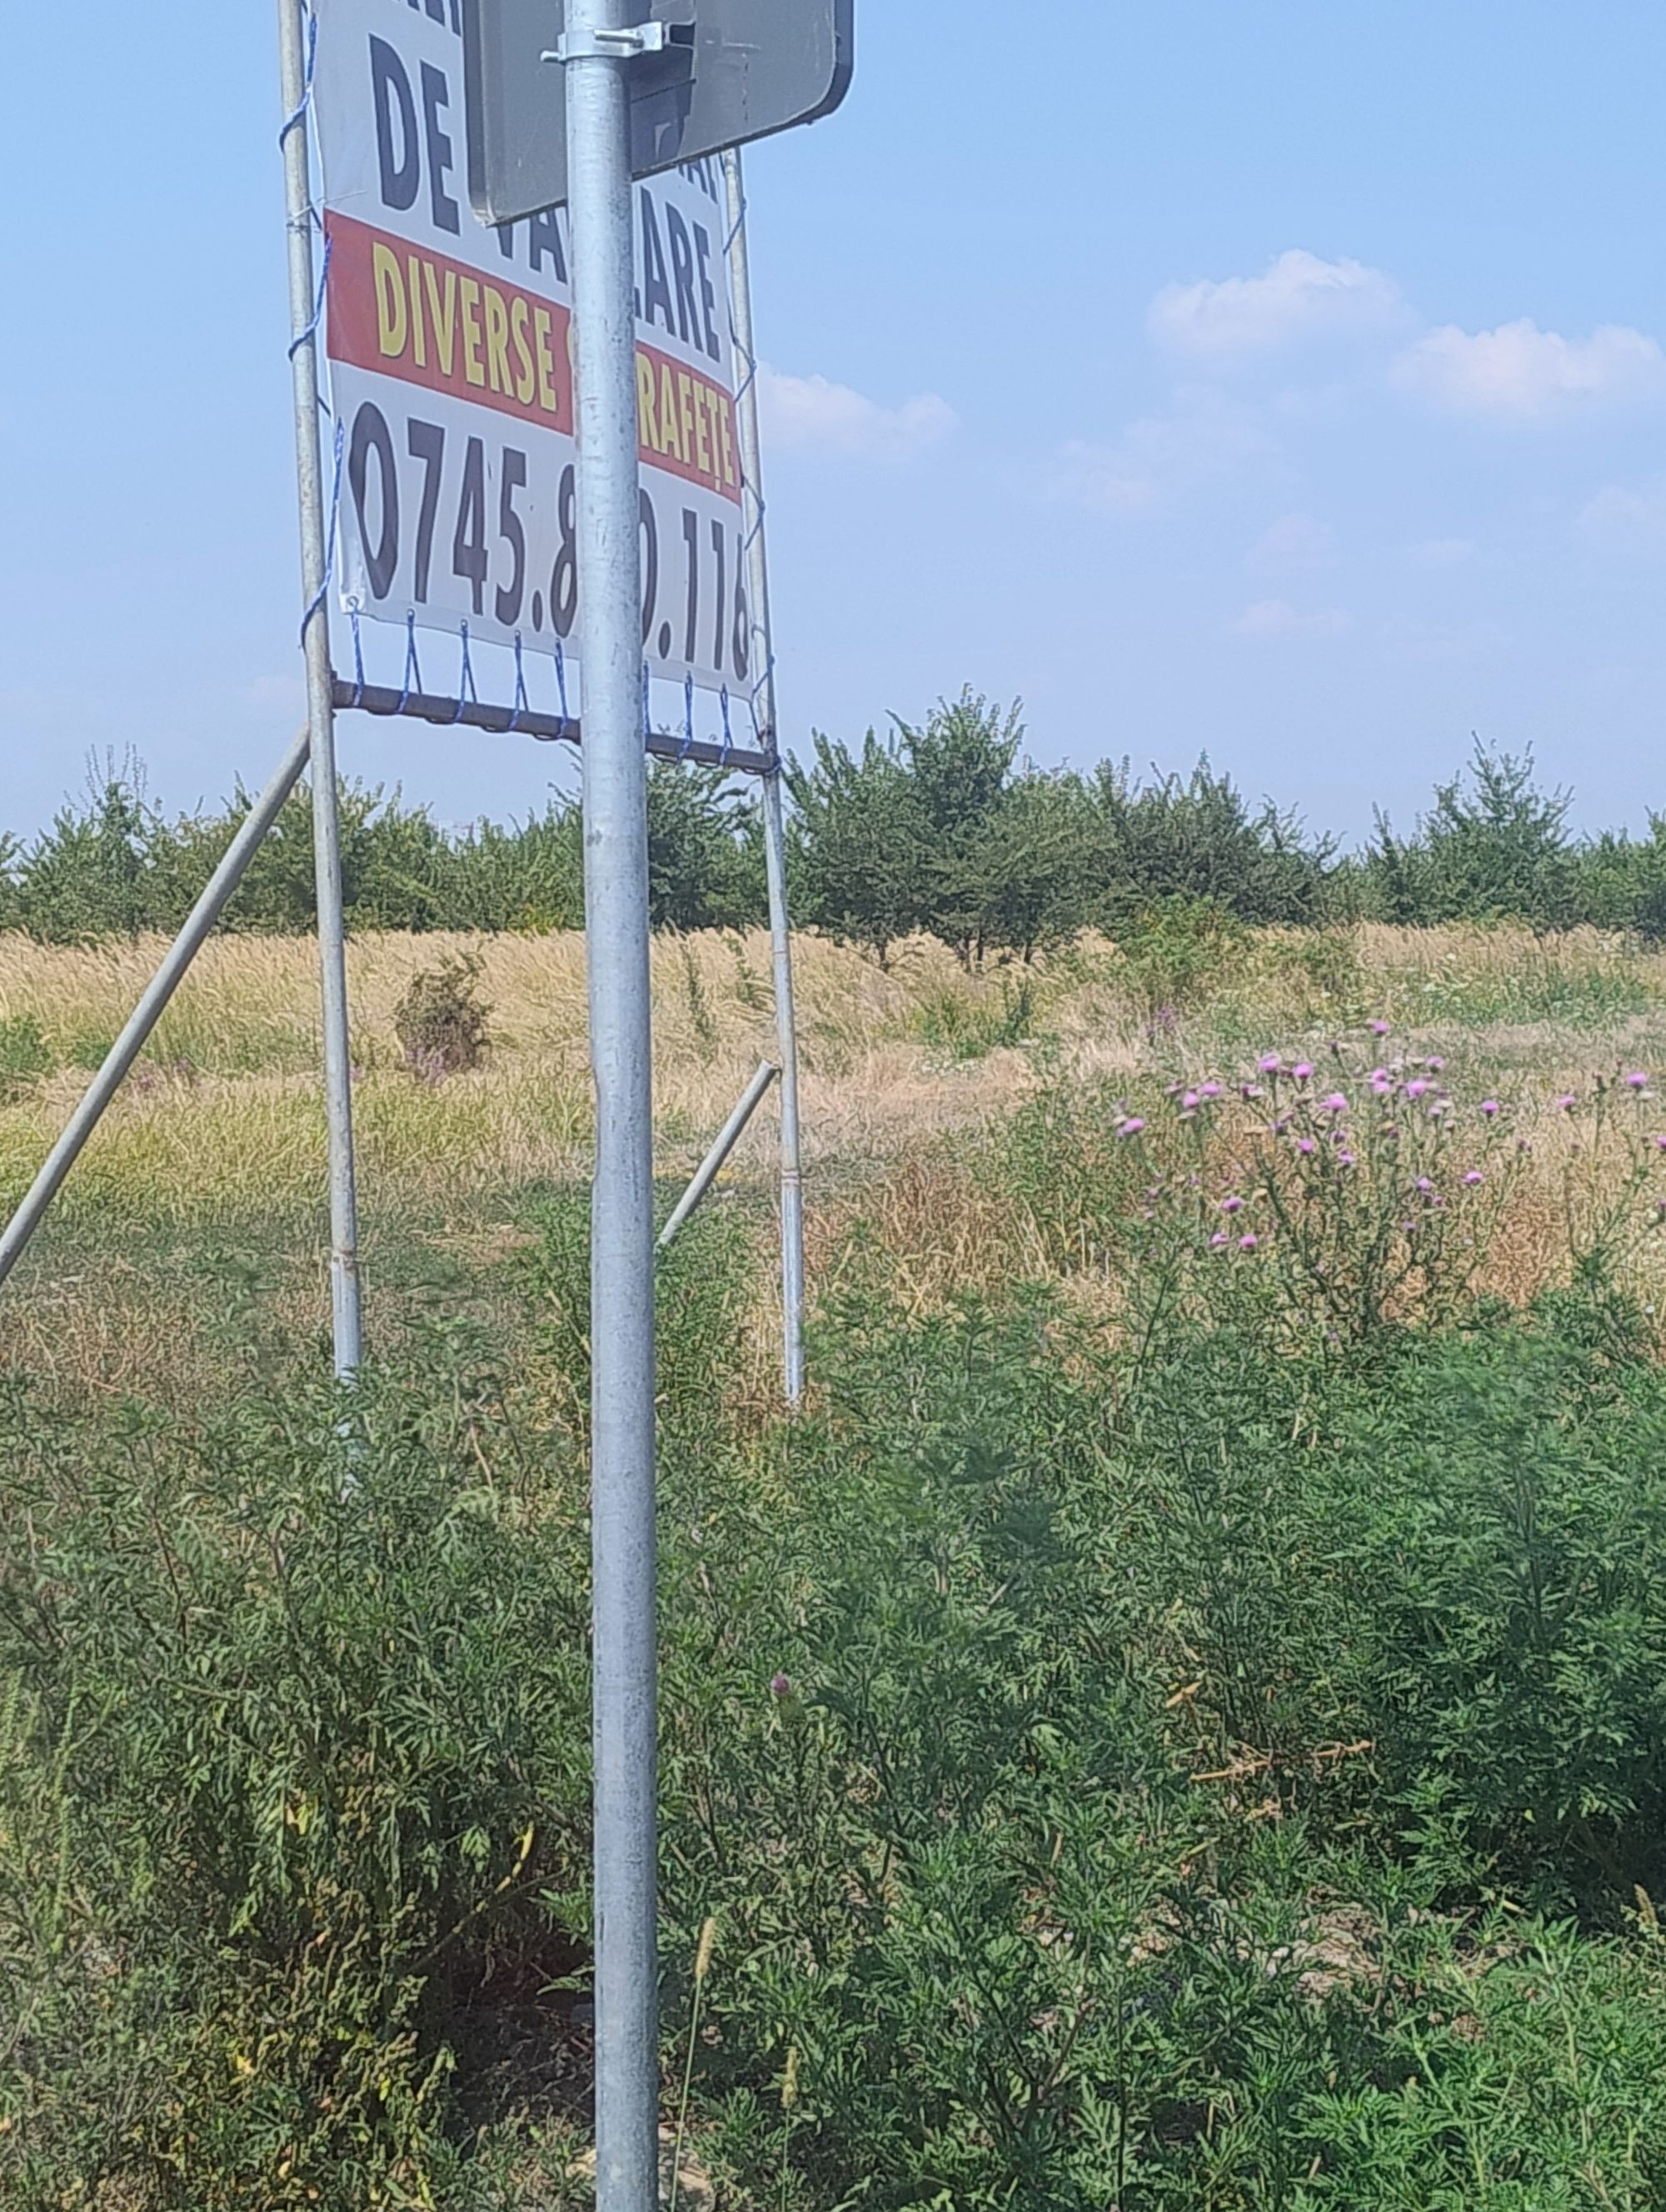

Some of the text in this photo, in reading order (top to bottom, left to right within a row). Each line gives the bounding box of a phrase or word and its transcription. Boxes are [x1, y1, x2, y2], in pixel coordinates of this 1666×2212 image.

[368, 32, 461, 237] DE
[372, 241, 556, 413] DIVERSE
[348, 401, 749, 681] 0745.80.116
